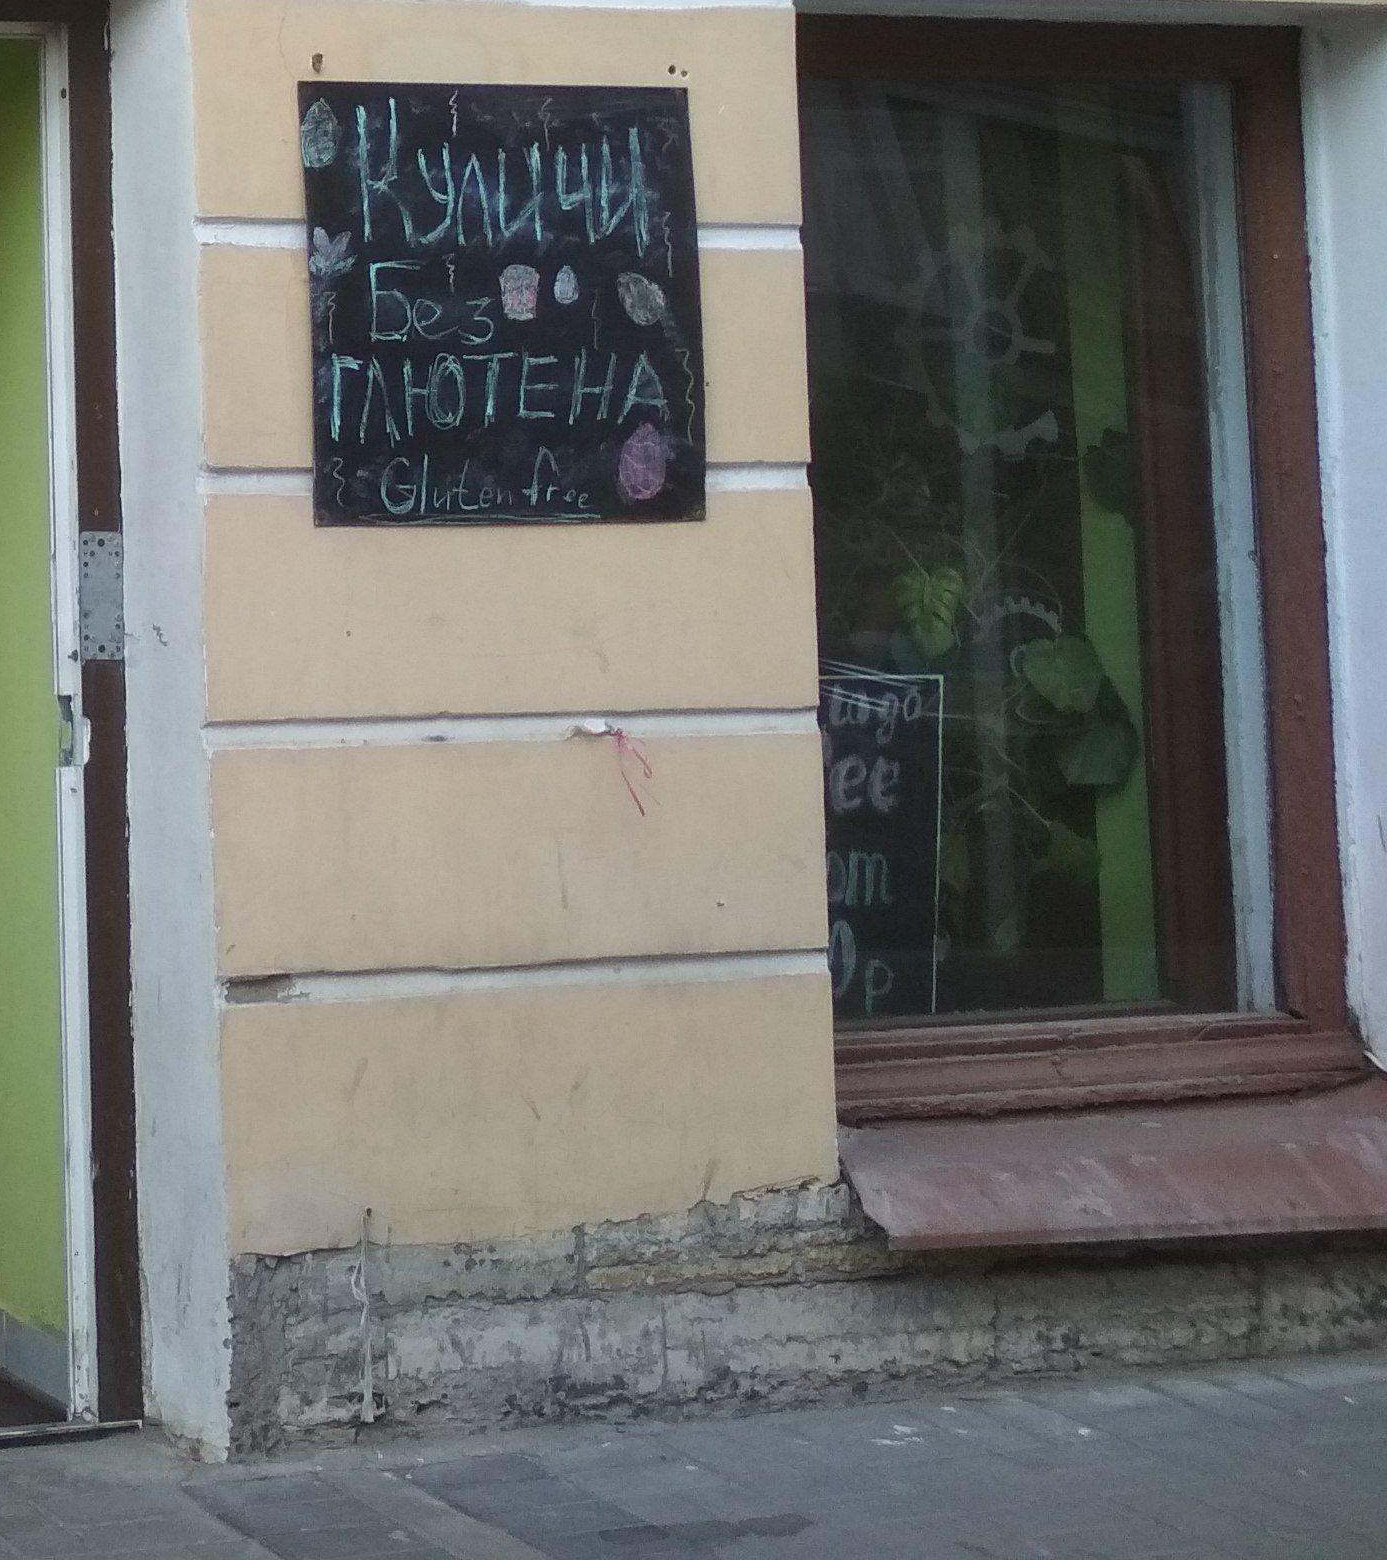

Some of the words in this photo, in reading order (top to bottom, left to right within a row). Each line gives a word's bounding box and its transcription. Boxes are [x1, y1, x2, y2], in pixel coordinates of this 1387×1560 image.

[369, 262, 495, 344] Без
[330, 348, 669, 447] ГЛЮТЕНА
[381, 454, 512, 514] Gluten
